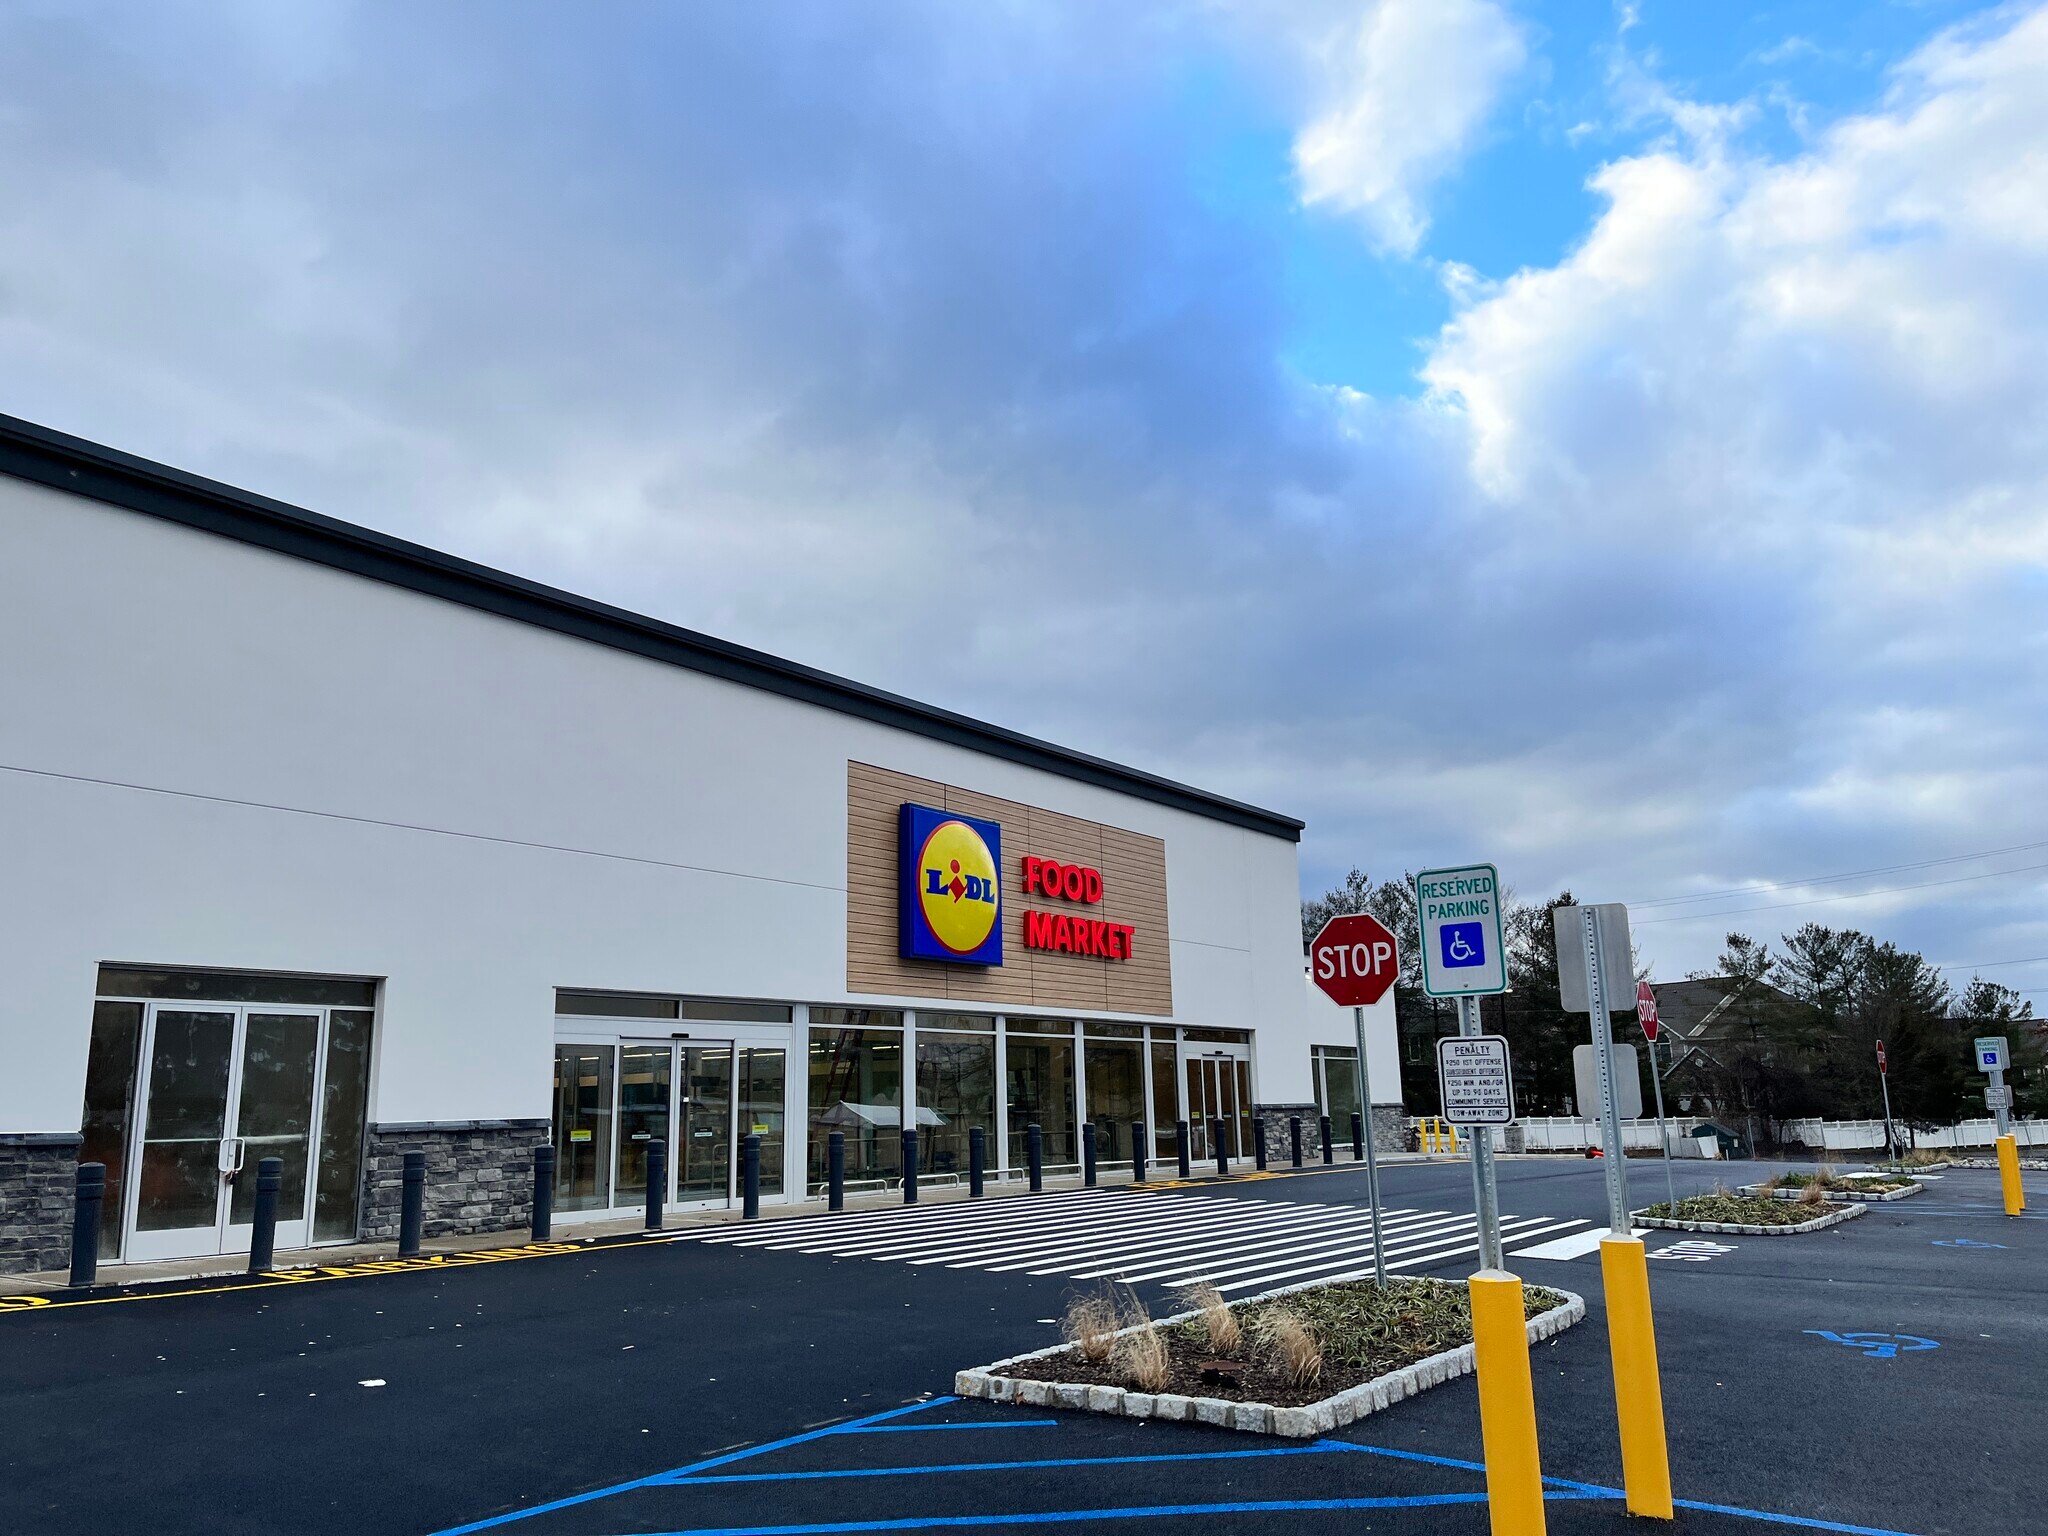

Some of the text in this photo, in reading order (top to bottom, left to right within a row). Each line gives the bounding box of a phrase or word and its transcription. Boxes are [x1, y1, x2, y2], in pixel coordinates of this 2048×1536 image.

[1022, 856, 1103, 904] FOOD
[1422, 877, 1492, 899] RESERVED
[1428, 899, 1489, 919] PARKING
[1023, 910, 1135, 959] MARKET
[1318, 942, 1391, 979] STOP
[1638, 999, 1655, 1022] STOP
[1455, 1046, 1490, 1054] PENALTY
[257, 1243, 581, 1281] PARKING
